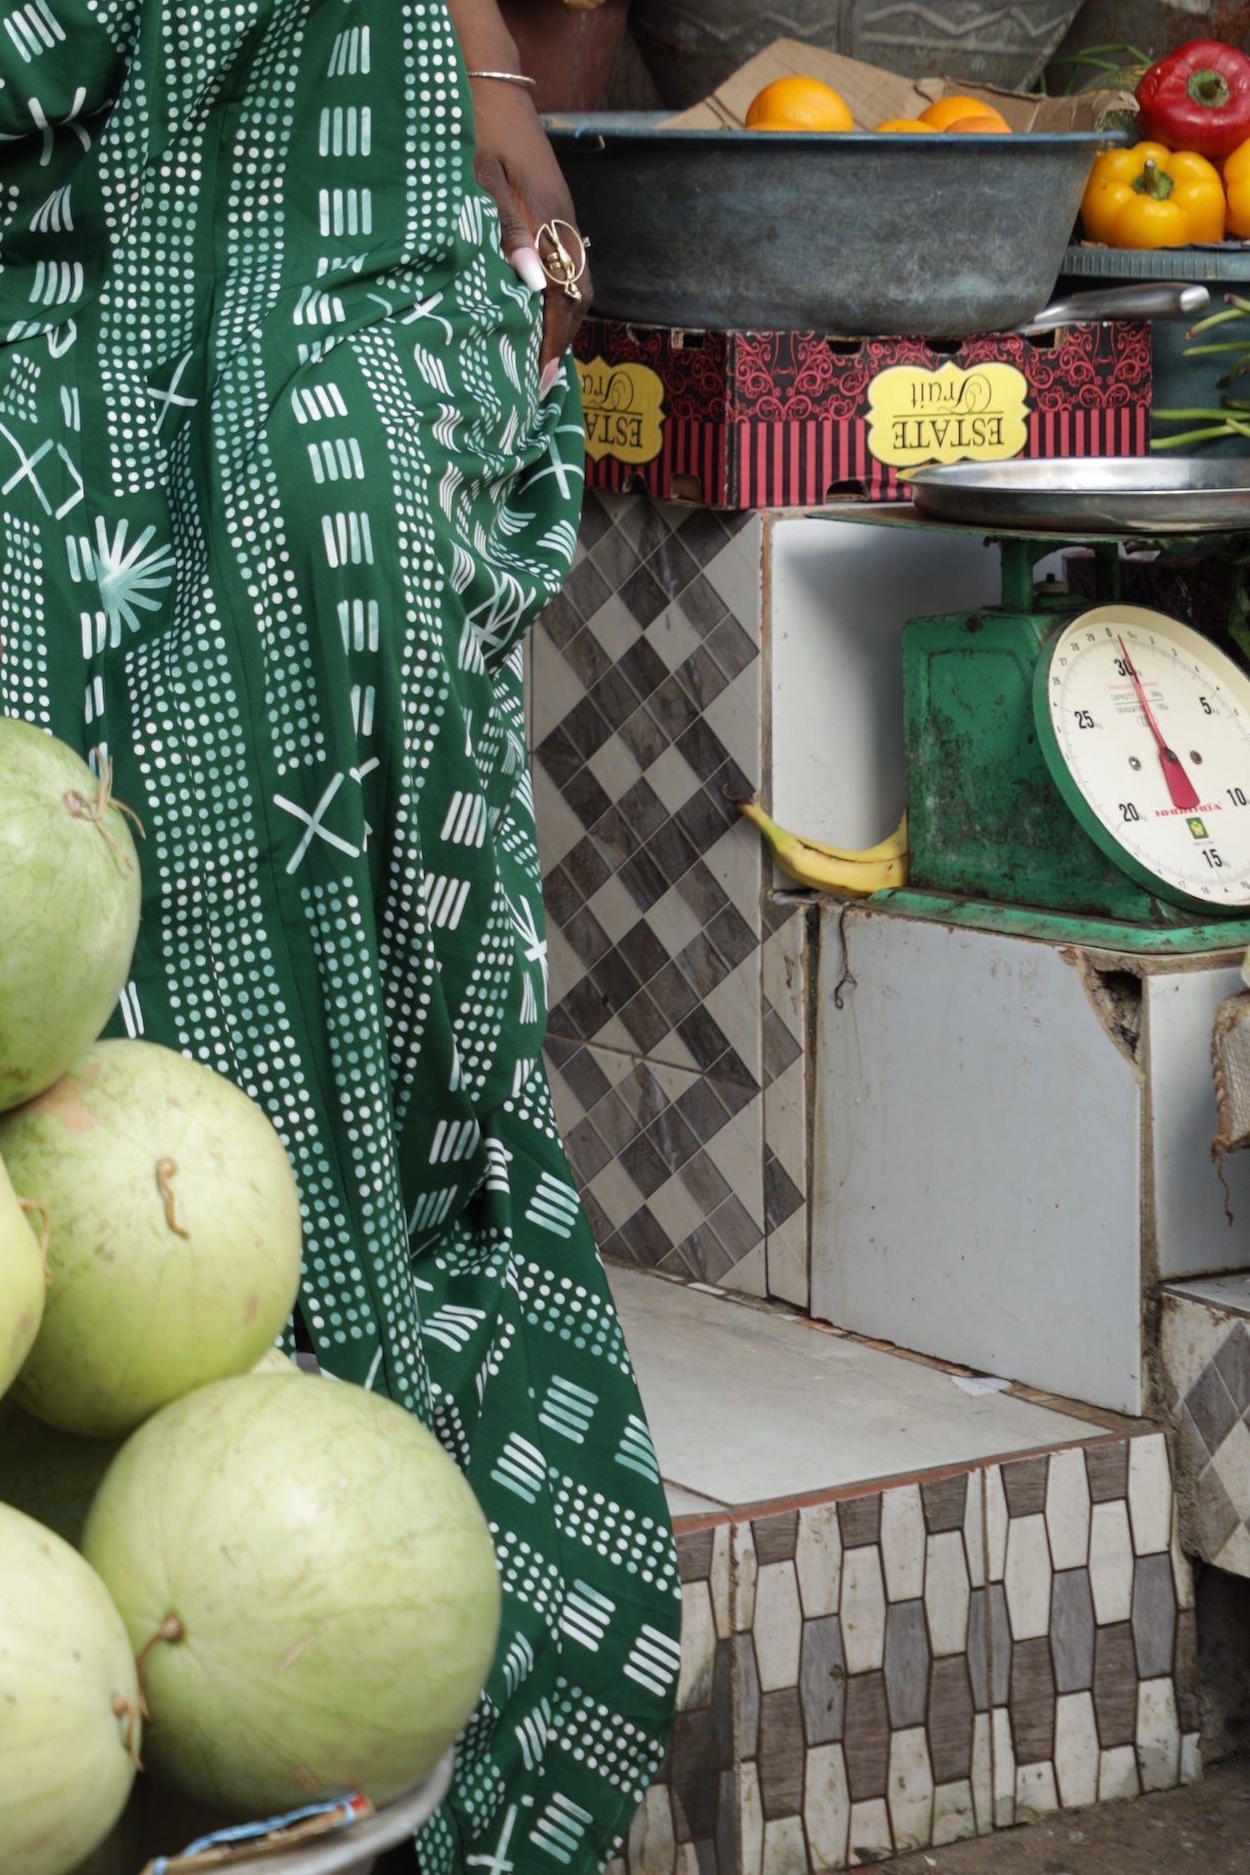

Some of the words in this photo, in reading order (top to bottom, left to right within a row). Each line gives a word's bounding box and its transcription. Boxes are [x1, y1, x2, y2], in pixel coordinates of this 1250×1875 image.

[582, 372, 634, 414] Fru
[910, 373, 993, 416] Fruit
[584, 416, 642, 449] ESTA
[891, 418, 1004, 450] ESTATE
[1105, 627, 1113, 637] 0
[1199, 696, 1212, 714] 5
[1074, 710, 1095, 729] 25
[1226, 787, 1247, 806] 10
[1119, 802, 1140, 822] 20
[1202, 849, 1223, 868] 15
